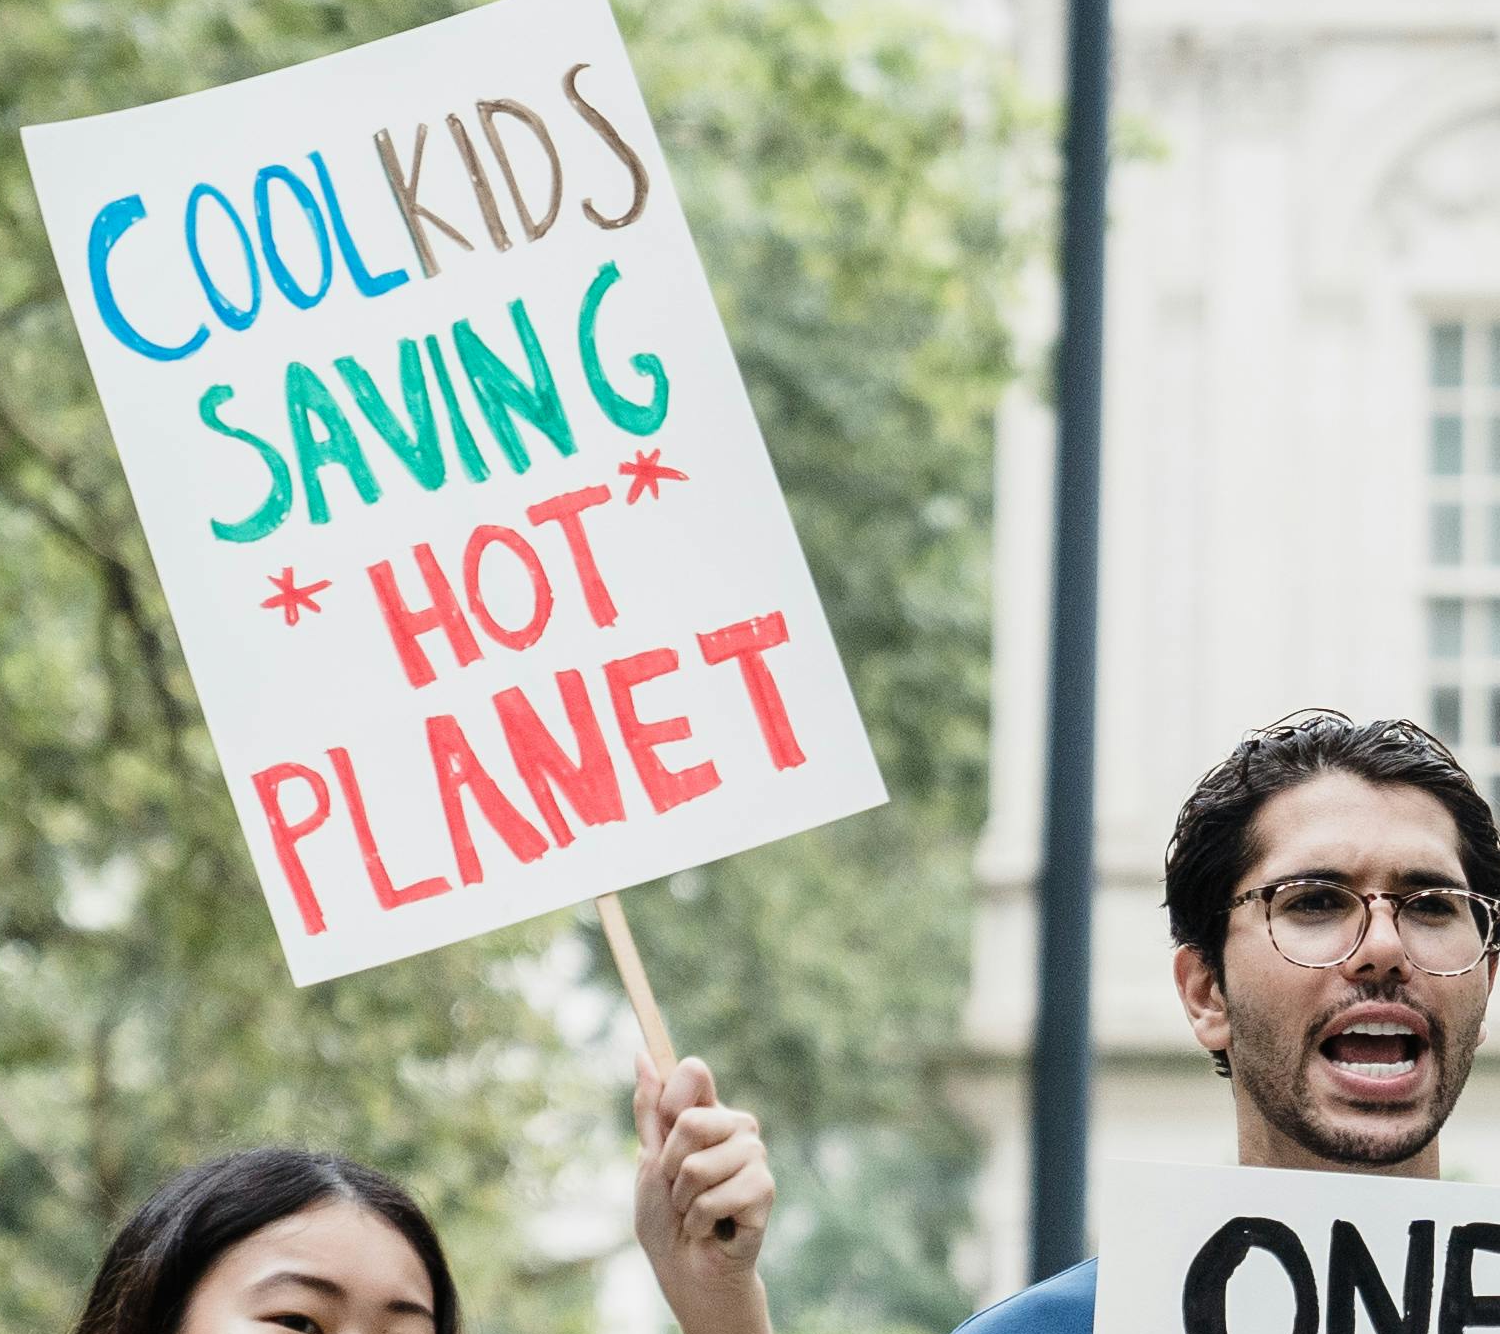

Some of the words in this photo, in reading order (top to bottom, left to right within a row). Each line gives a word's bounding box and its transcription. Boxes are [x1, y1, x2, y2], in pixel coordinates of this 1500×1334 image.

[87, 152, 410, 362] COOL
[376, 64, 649, 278] KIDS
[198, 261, 670, 543] SAVING
[252, 611, 806, 935] PLANET
